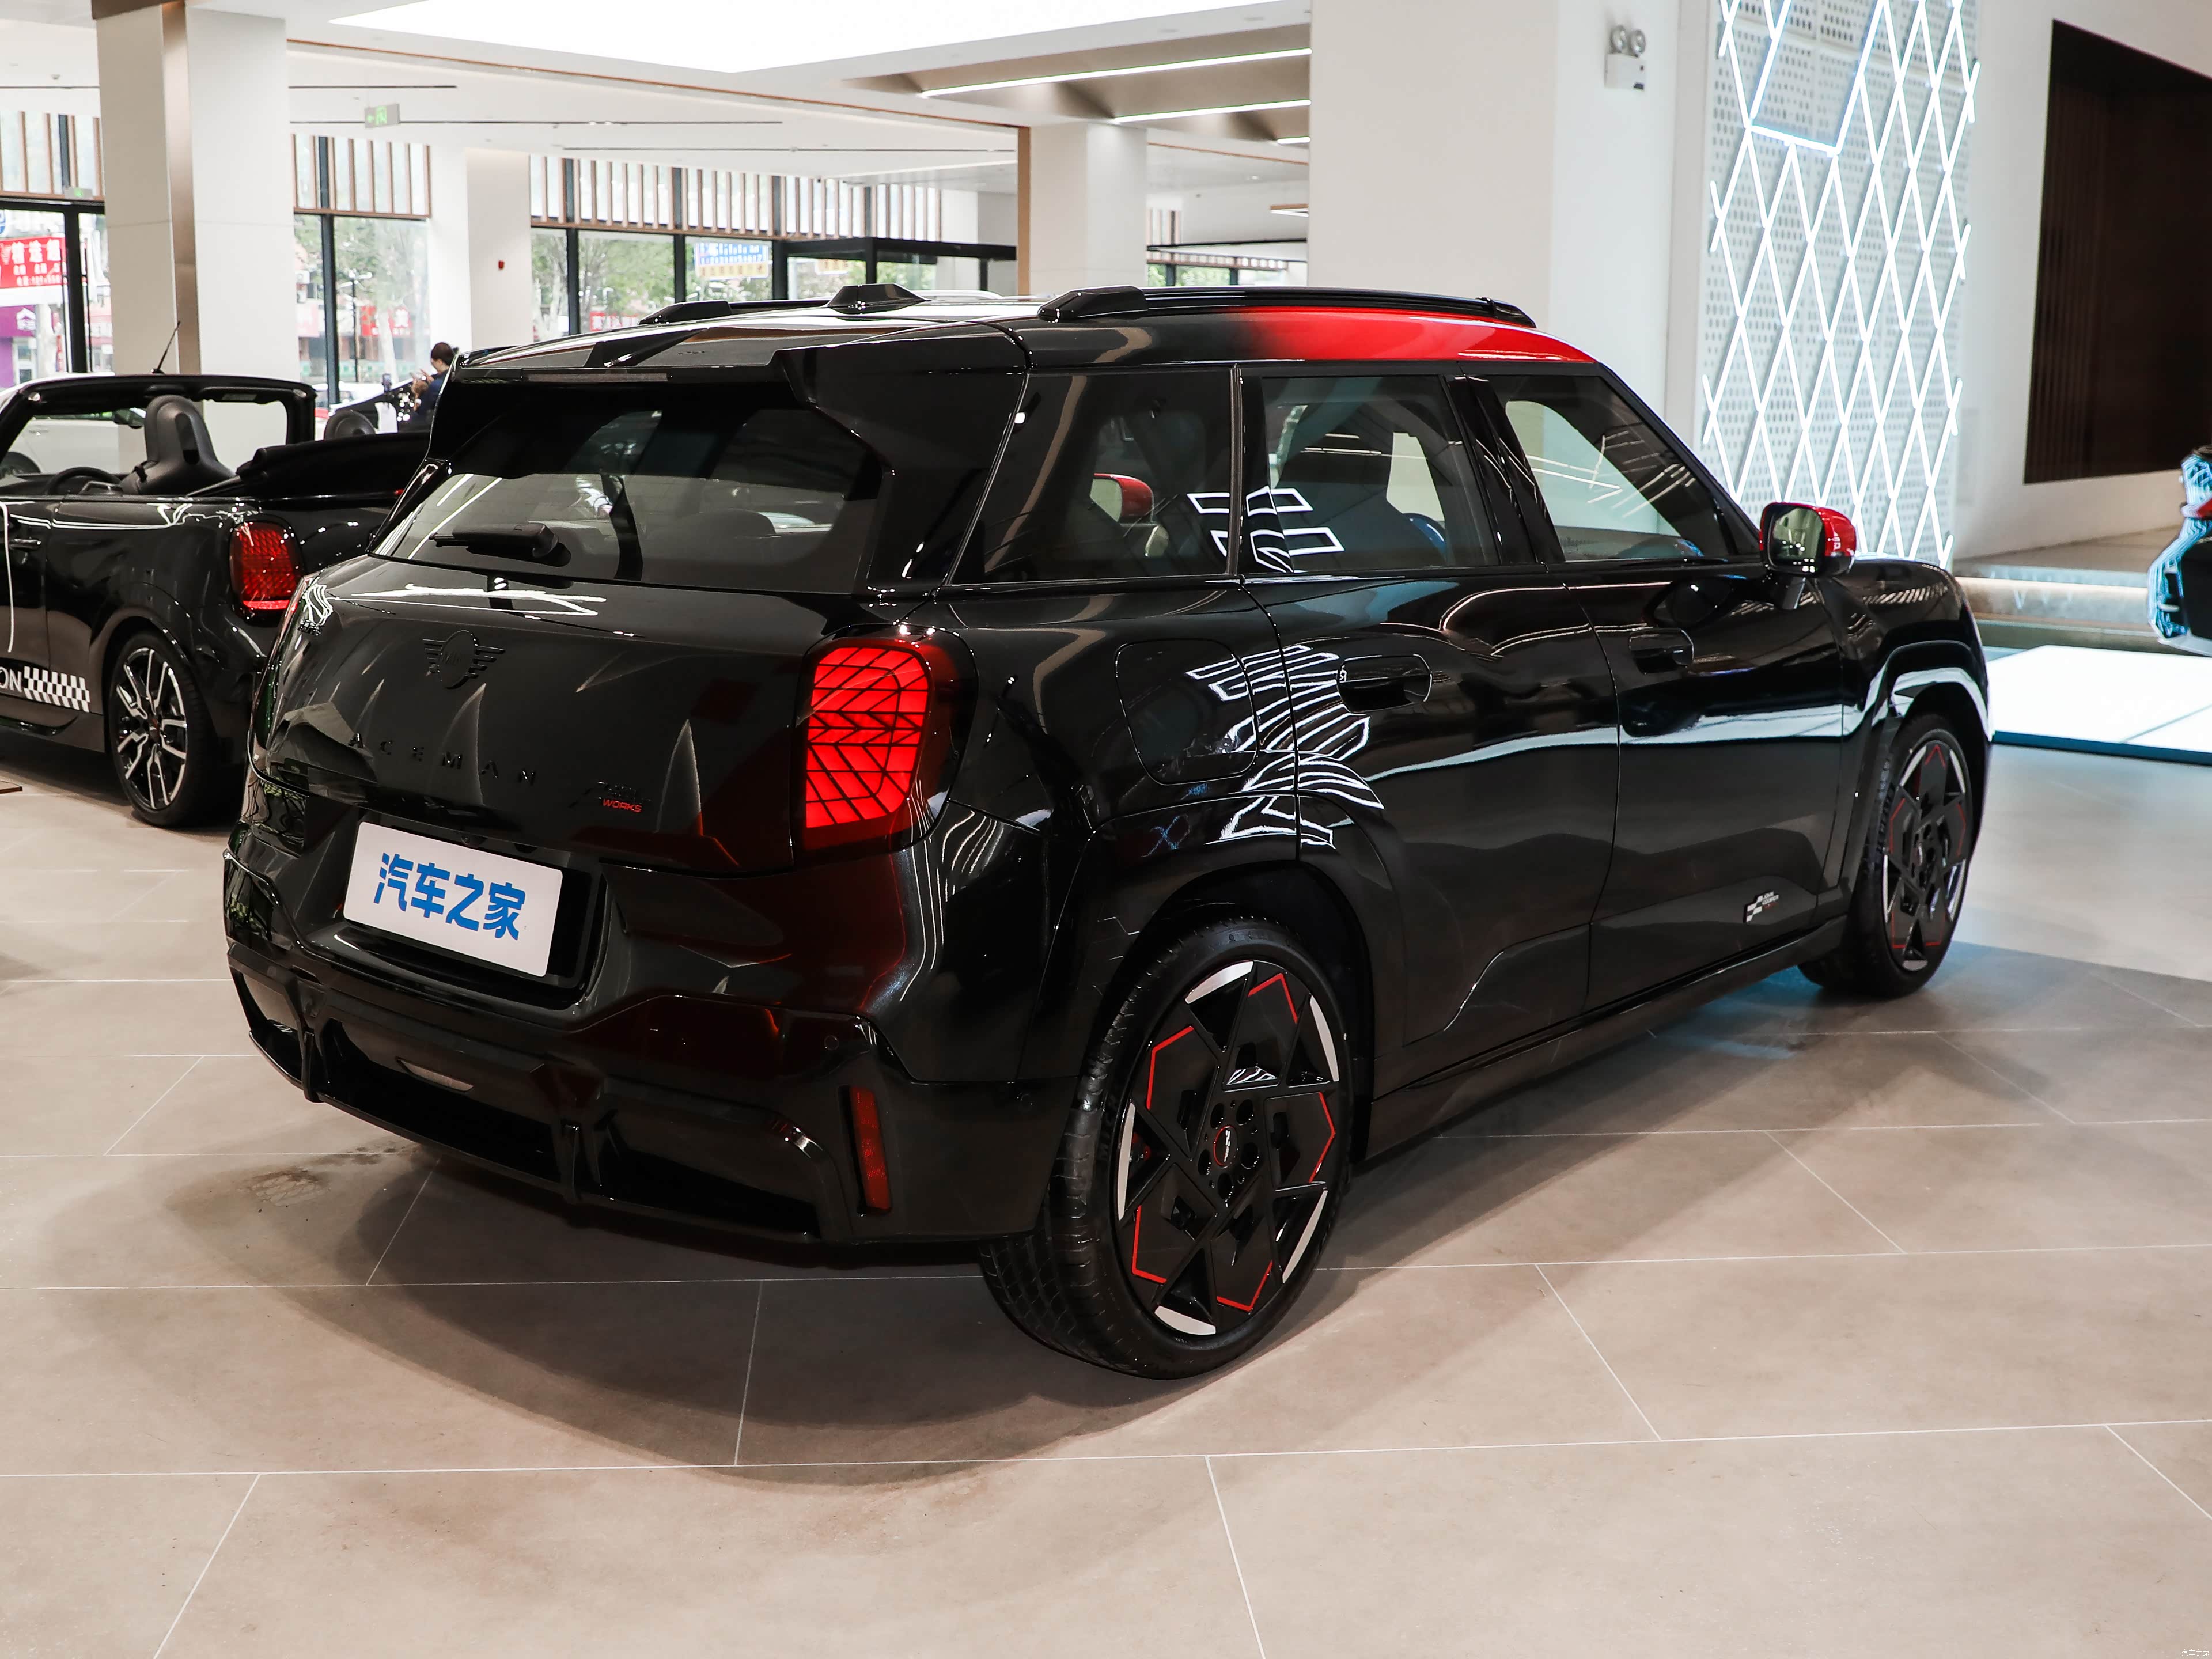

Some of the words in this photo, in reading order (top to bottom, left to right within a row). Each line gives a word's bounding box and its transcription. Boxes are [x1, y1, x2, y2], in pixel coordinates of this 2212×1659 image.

[603, 798, 643, 813] WORKS
[373, 852, 526, 941] 汽车之家
